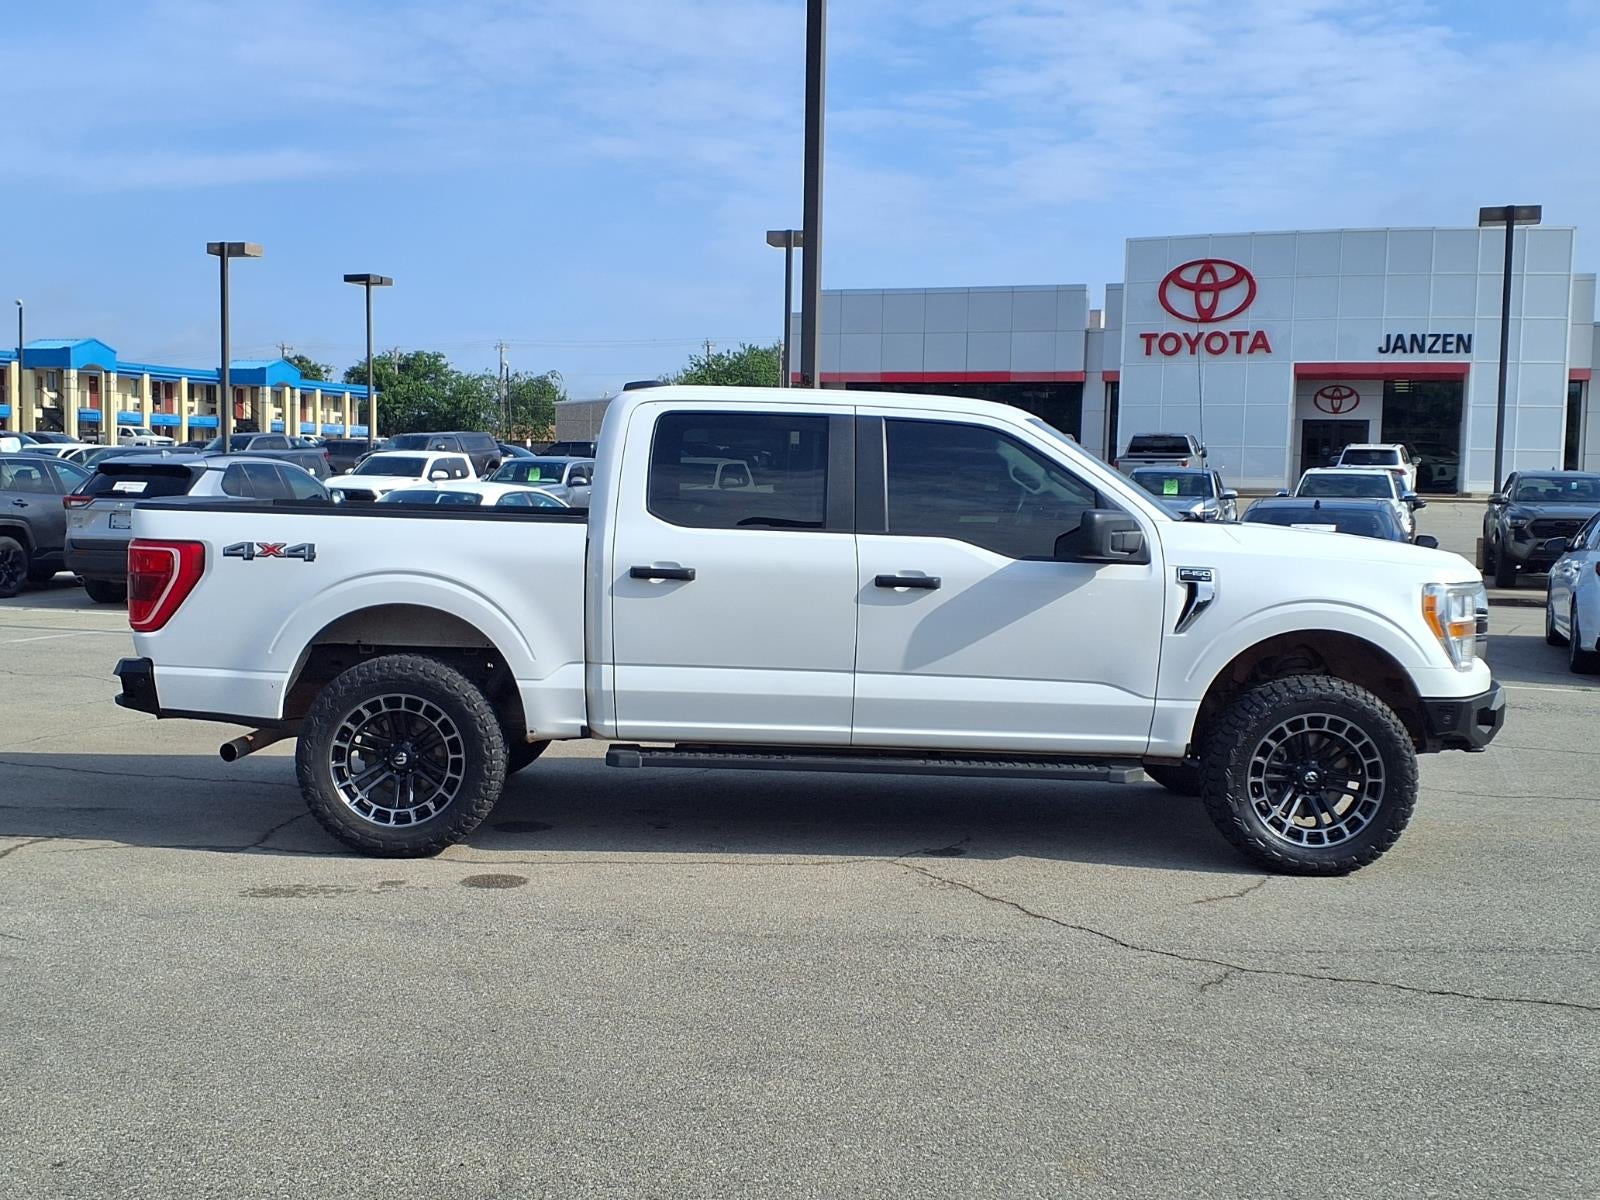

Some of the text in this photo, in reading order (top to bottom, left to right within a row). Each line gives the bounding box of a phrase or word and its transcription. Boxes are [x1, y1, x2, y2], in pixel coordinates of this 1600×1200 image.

[1139, 330, 1272, 356] TOYOTA
[1377, 333, 1473, 354] JANZEN
[222, 541, 316, 562] 4X4
